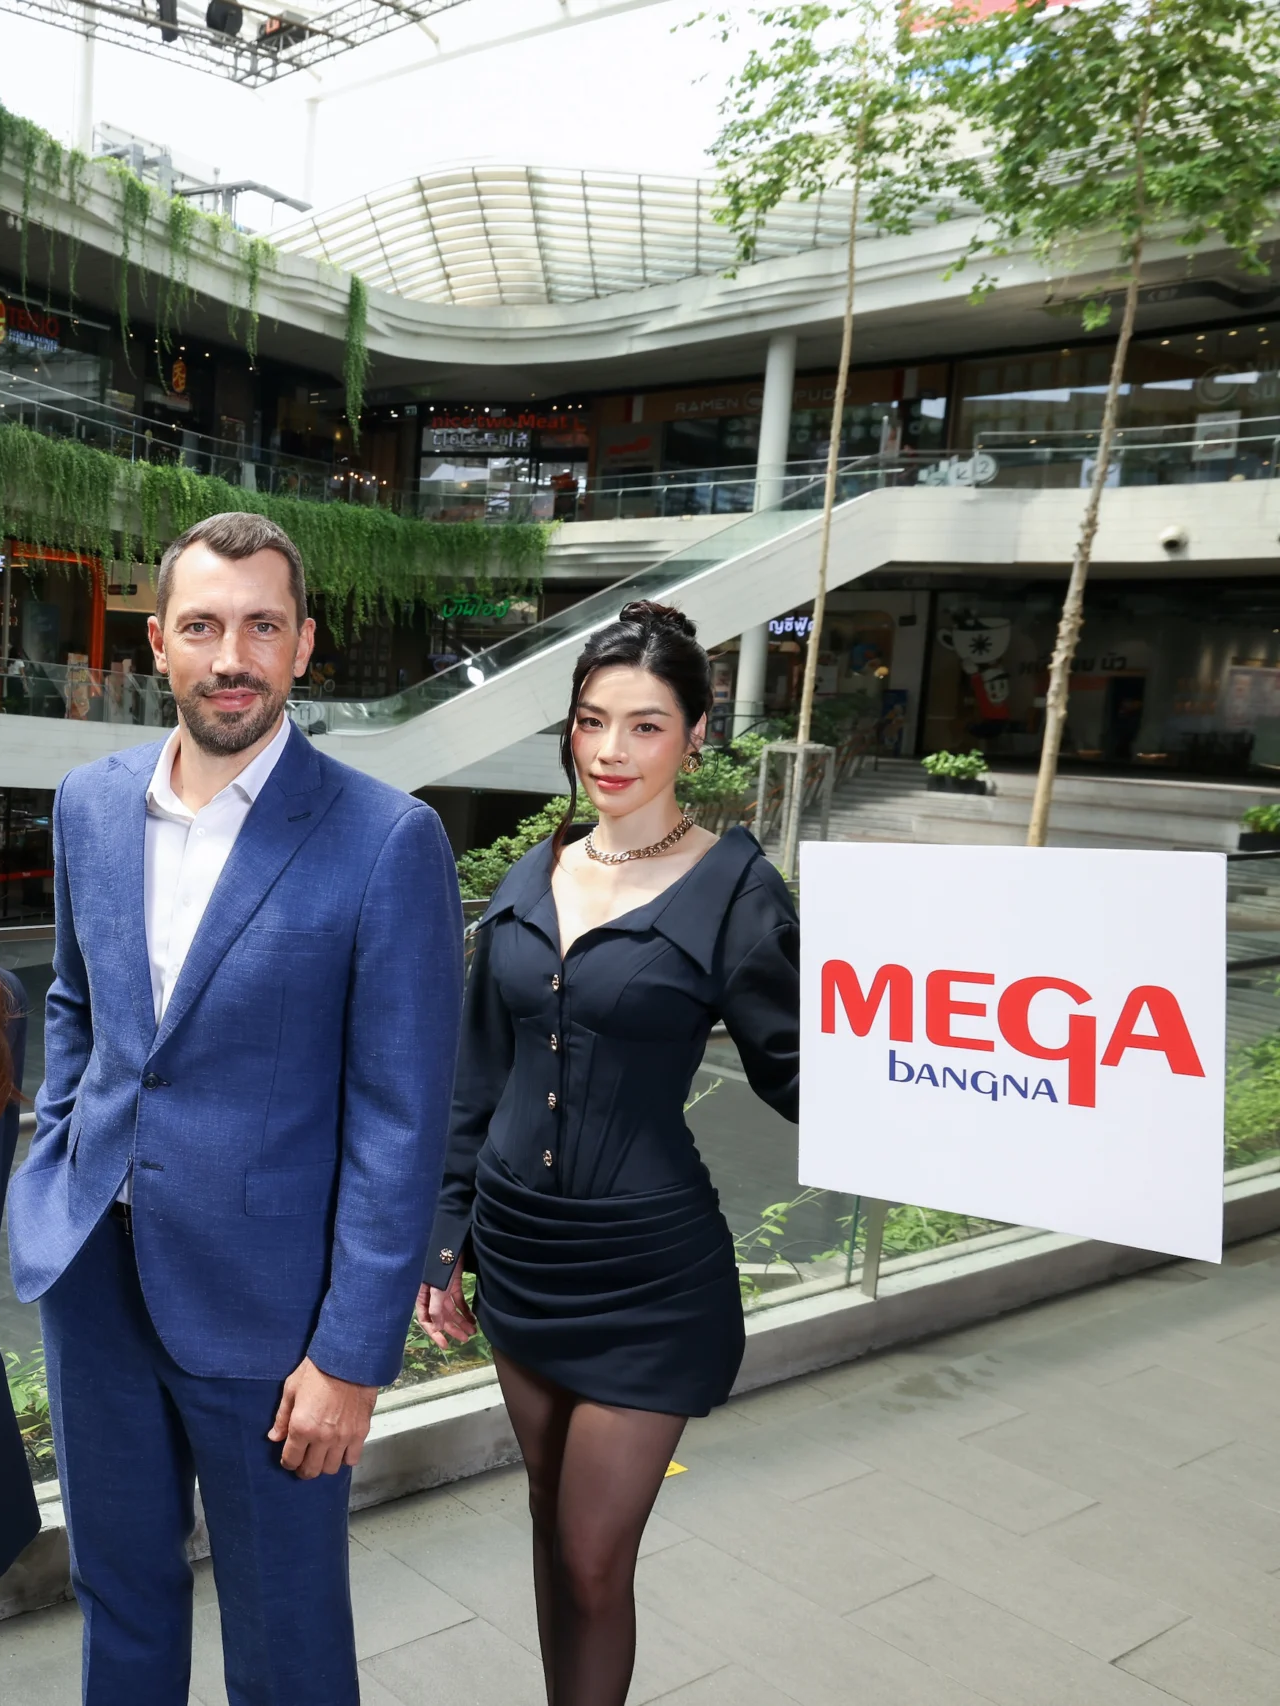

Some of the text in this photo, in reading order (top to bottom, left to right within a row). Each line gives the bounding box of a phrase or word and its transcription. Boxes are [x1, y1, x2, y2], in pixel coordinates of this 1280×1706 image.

[674, 399, 739, 414] RAMEN
[477, 414, 514, 429] two
[517, 414, 568, 429] Meat
[821, 959, 1206, 1108] MEGA
